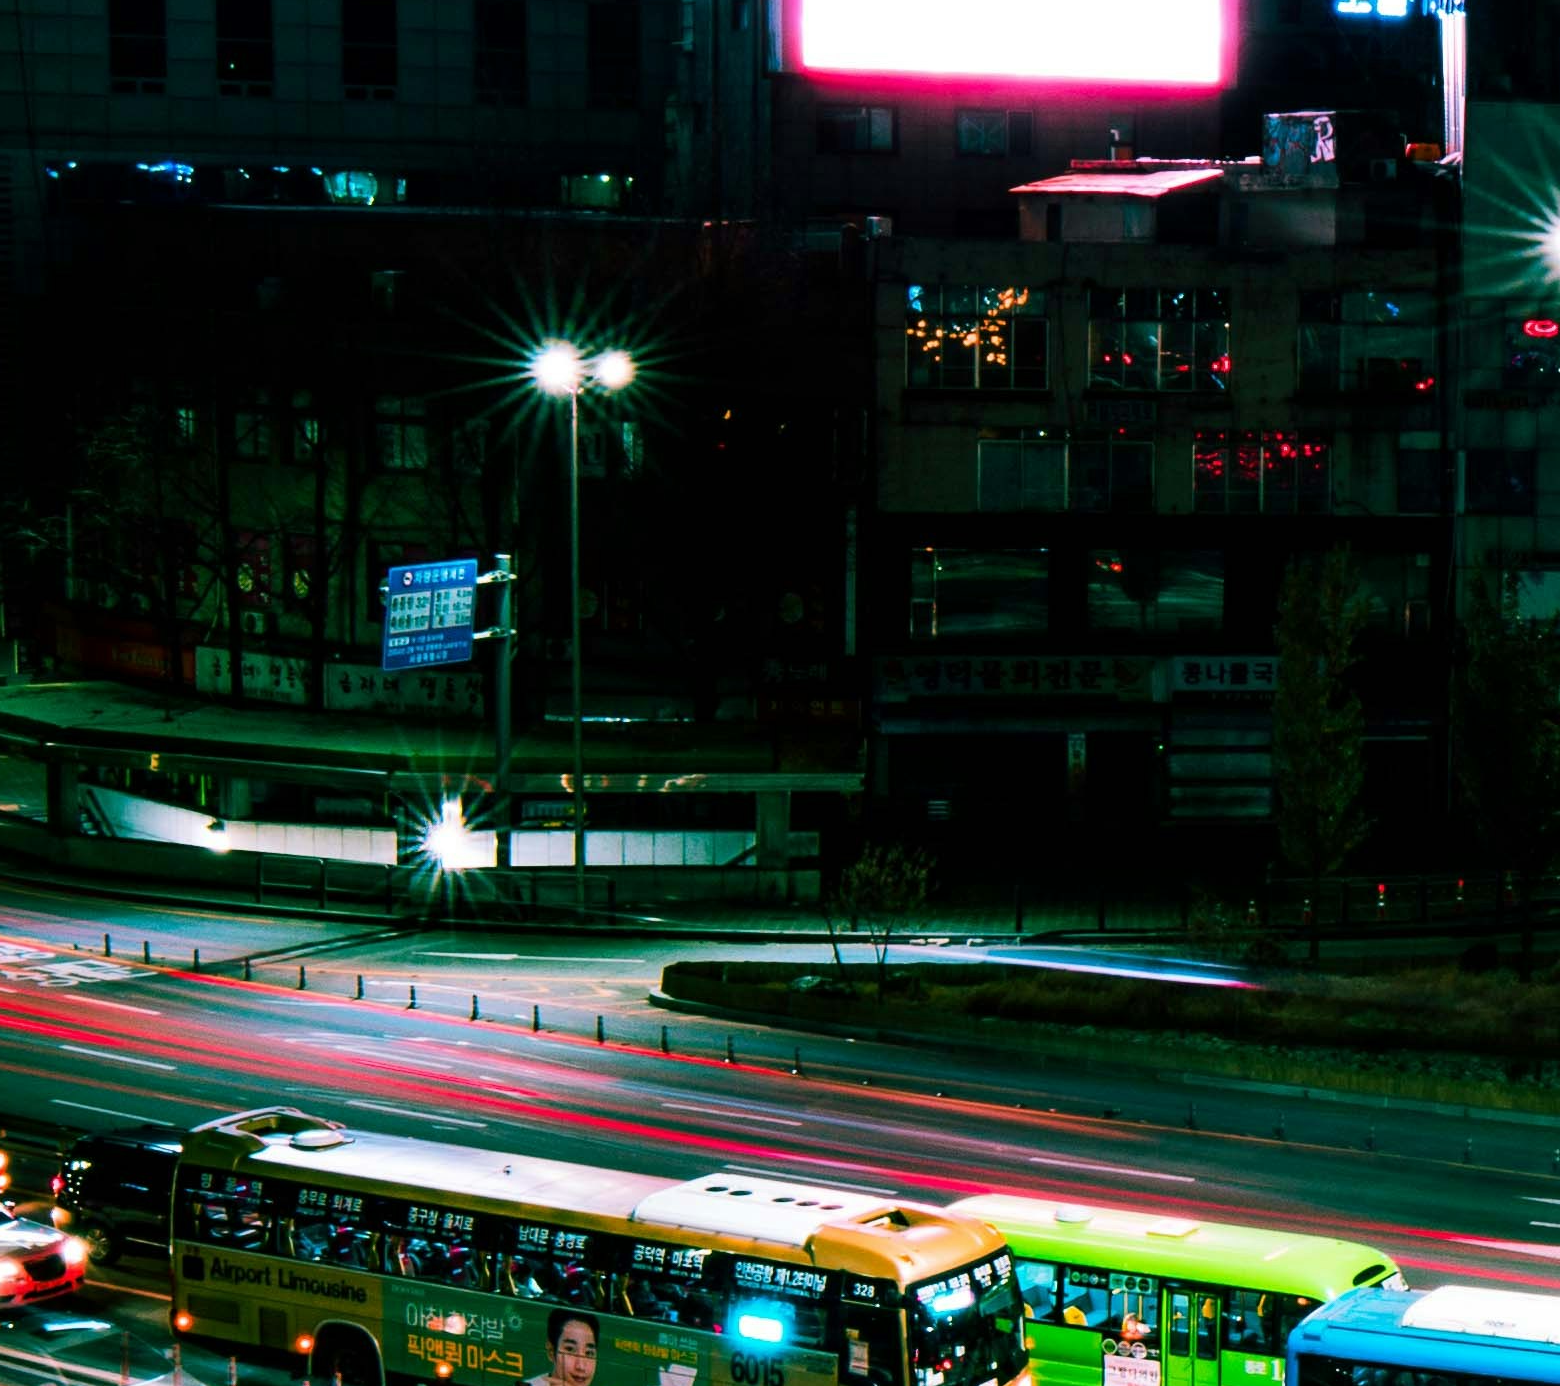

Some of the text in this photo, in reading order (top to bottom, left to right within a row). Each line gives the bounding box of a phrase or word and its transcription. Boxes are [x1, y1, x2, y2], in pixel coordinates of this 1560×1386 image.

[210, 1257, 271, 1288] Airport
[278, 1268, 368, 1303] Limousine
[853, 1282, 876, 1298] 328
[466, 1346, 524, 1378] 마스크
